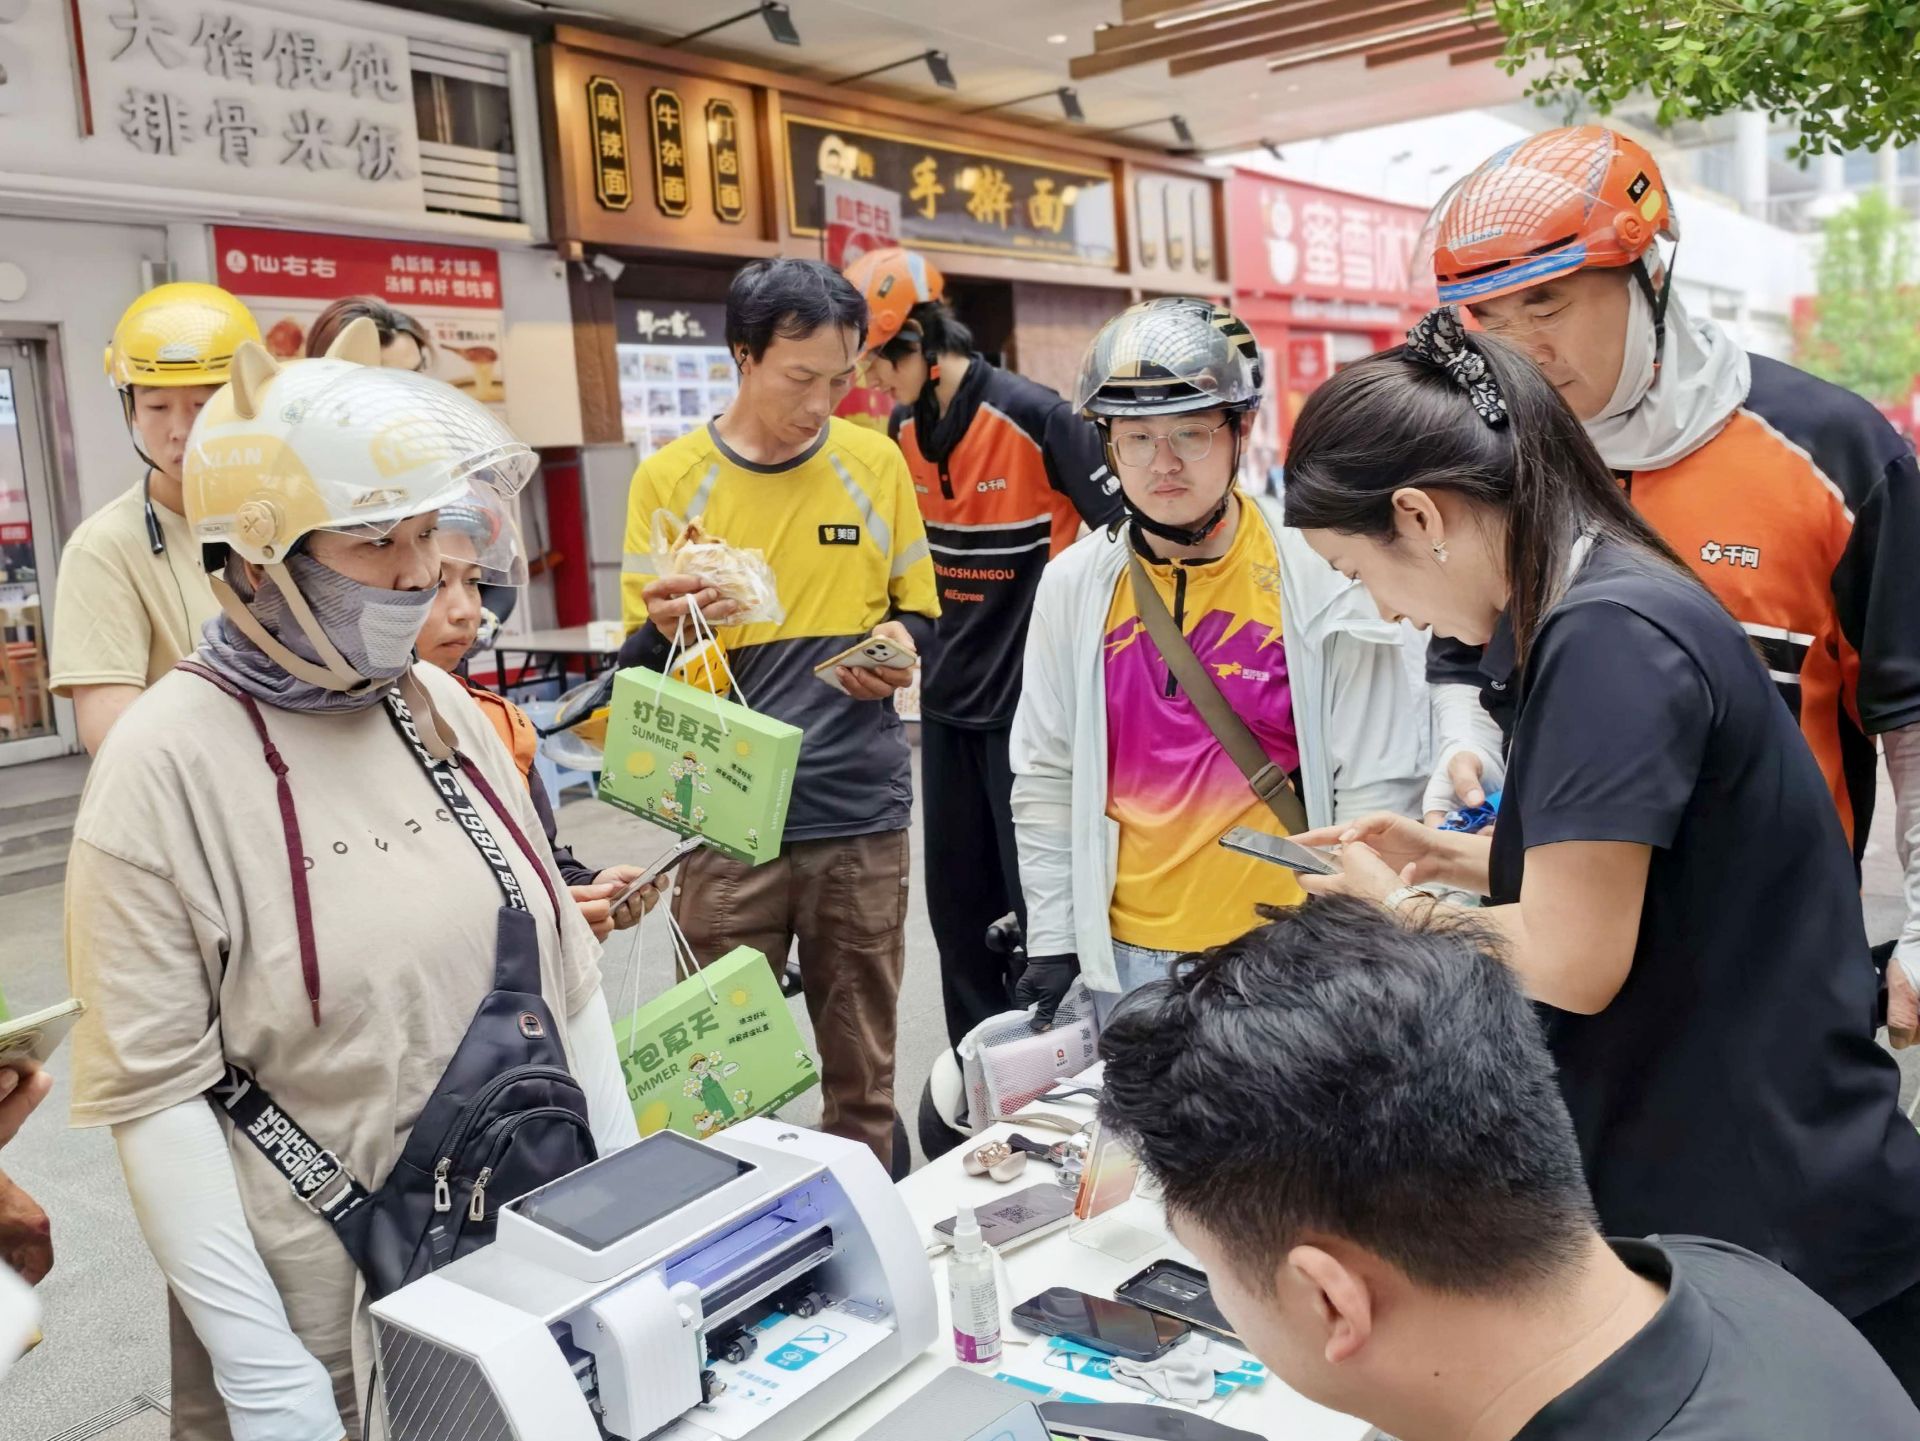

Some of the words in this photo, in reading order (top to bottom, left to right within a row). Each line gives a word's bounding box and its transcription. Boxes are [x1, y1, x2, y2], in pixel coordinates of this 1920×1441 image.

[119, 86, 411, 181] 排骨米饭
[658, 103, 686, 203] 牛杂面
[252, 253, 338, 278] 仙右右
[1301, 202, 1422, 291] 蜜雪冰
[837, 528, 857, 540] 美团
[1722, 545, 1760, 569] 千问
[632, 724, 679, 753] SUMMER
[633, 699, 723, 754] 打包夏天
[621, 1006, 720, 1086] 包夏天
[628, 1063, 681, 1102] UMMER
